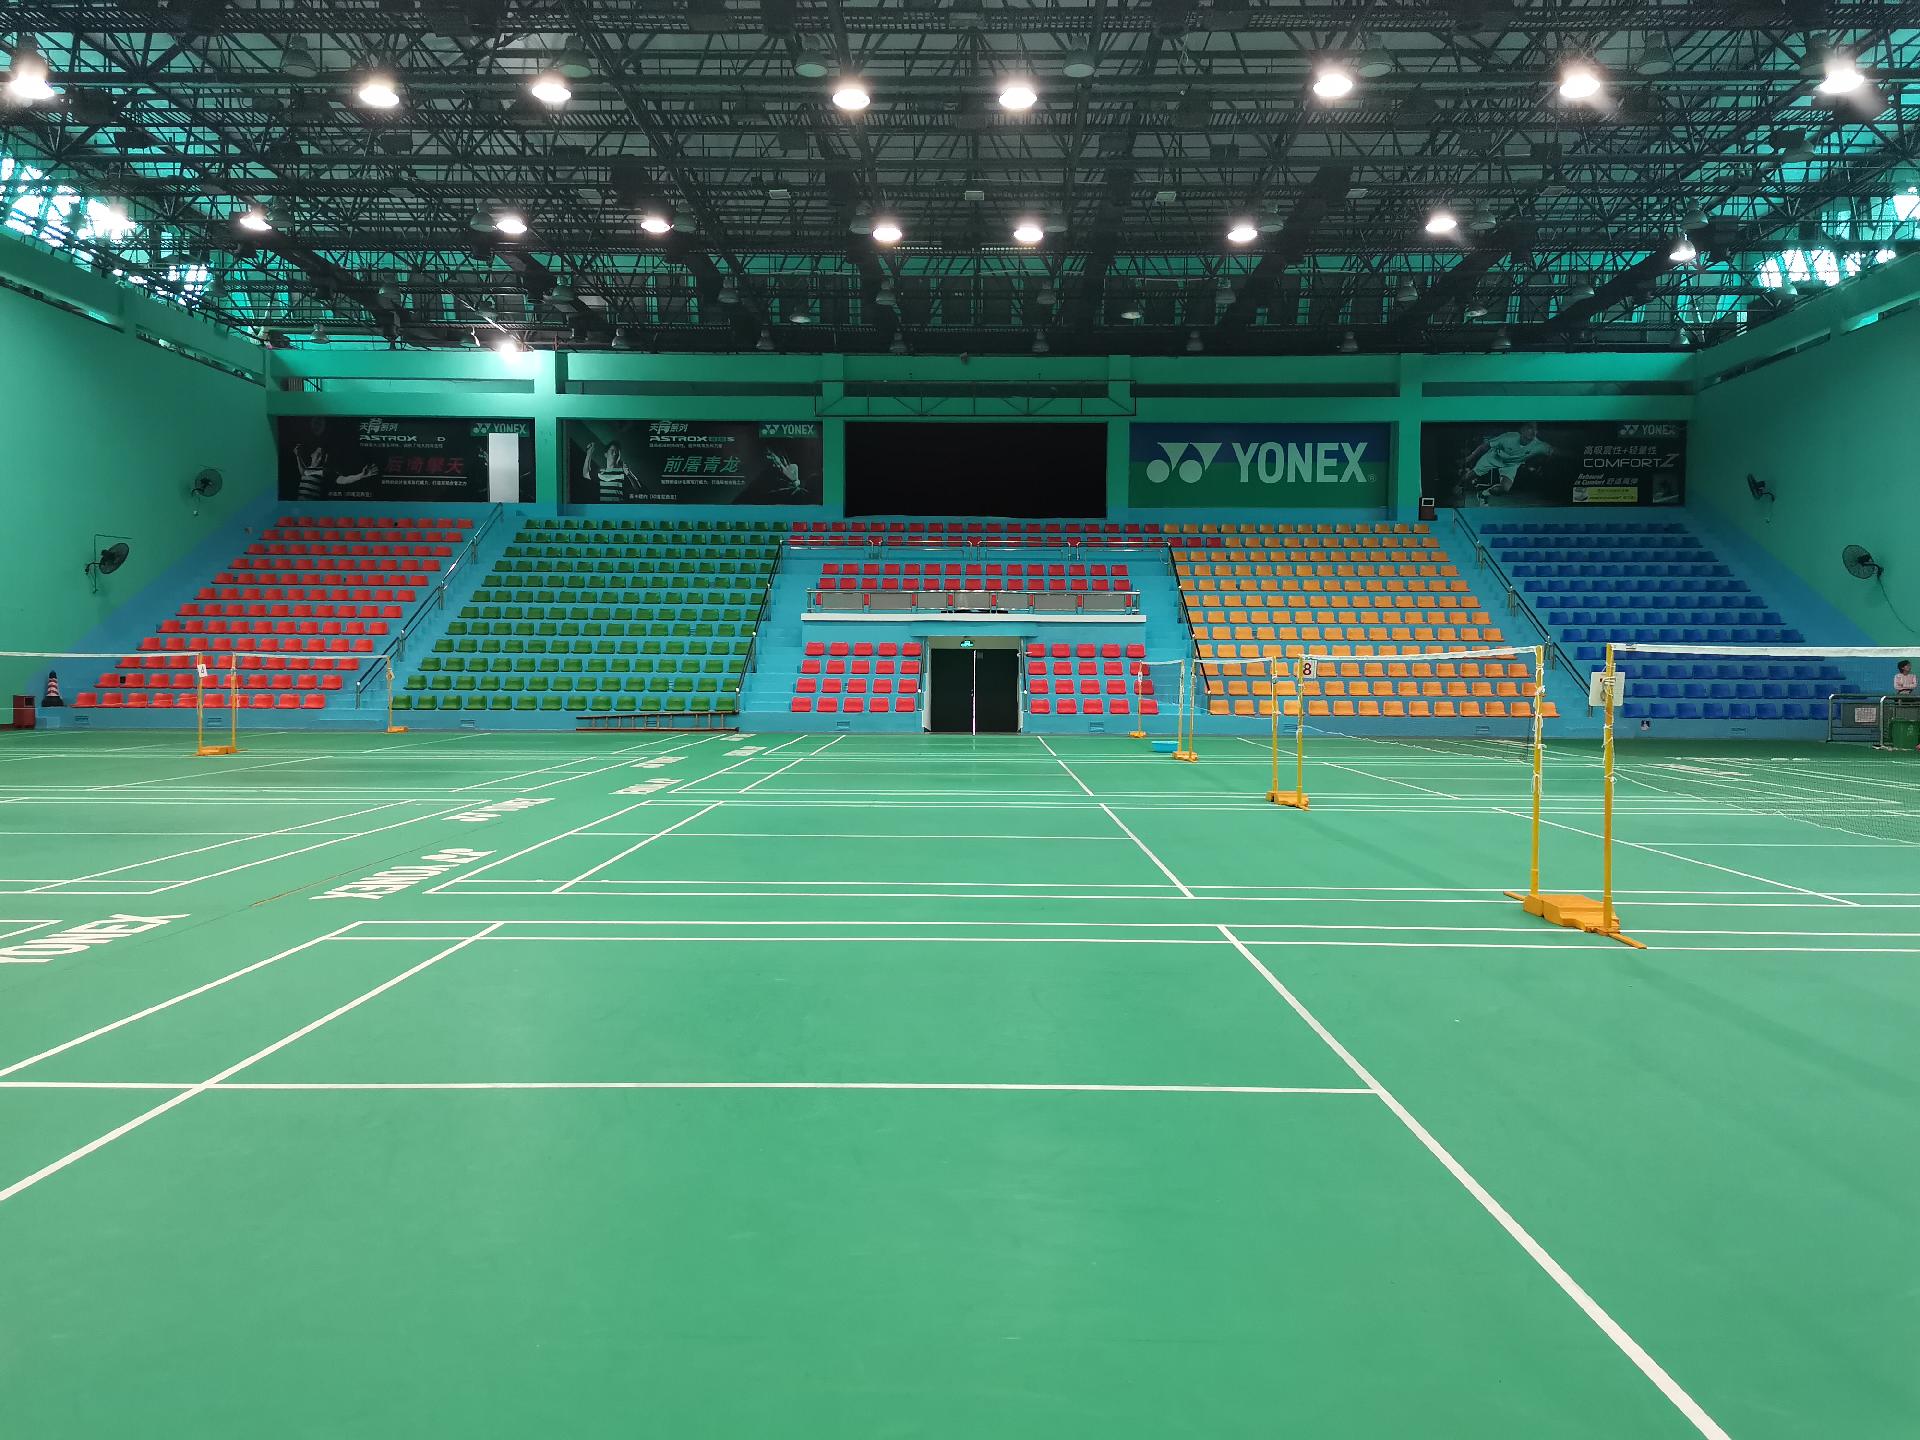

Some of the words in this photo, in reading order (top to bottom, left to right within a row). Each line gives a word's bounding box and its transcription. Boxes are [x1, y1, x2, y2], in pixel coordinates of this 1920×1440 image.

[781, 424, 814, 435] YONEX
[1642, 424, 1676, 435] YONEX
[1231, 441, 1368, 484] YONEX
[1303, 662, 1312, 676] 8
[308, 864, 461, 900] YONEX
